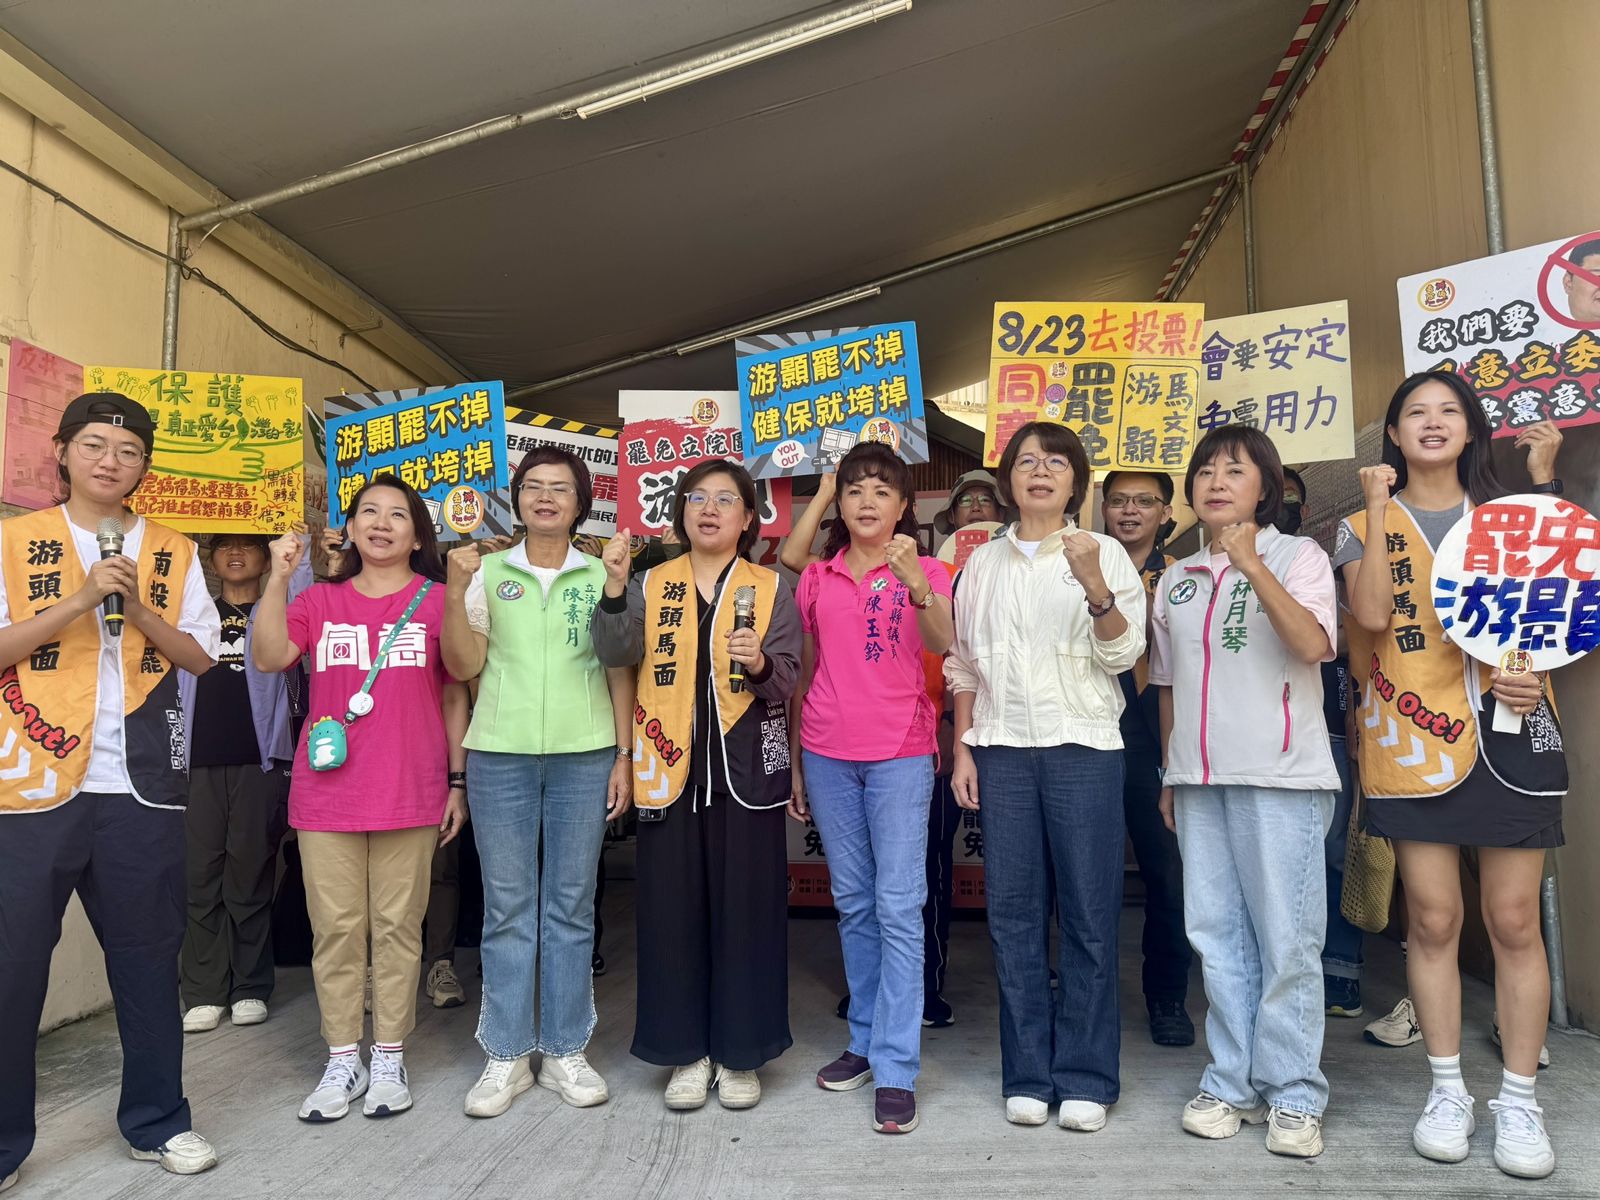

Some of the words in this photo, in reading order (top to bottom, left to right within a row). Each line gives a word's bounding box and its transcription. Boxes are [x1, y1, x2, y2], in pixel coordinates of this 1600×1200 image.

[998, 308, 1203, 356] 8/23去投票!
[1201, 317, 1347, 380] 會要安定
[1421, 302, 1536, 352] 我們要
[749, 330, 903, 396] 游顥罷不掉
[1431, 334, 1600, 388] 意立委
[149, 372, 244, 417] 保護
[337, 391, 490, 461] 游顥罷不掉
[752, 376, 908, 442] 健保就垮掉
[1159, 372, 1194, 464] 馬文君
[1480, 384, 1600, 428] 黨意
[777, 442, 797, 456] YOU
[781, 454, 800, 467] OUT
[1463, 500, 1600, 581] 罷免
[28, 540, 63, 671] 游頭面
[141, 548, 173, 673] 南投罷
[562, 587, 584, 647] 陳素月
[653, 581, 687, 687] 游頭馬面
[864, 595, 885, 663] 陳玉鈴
[1222, 579, 1252, 654] 林月琴
[317, 621, 427, 672] 同意
[1369, 652, 1396, 702] You
[1397, 691, 1465, 743] Out!
[645, 718, 683, 767] Out!
